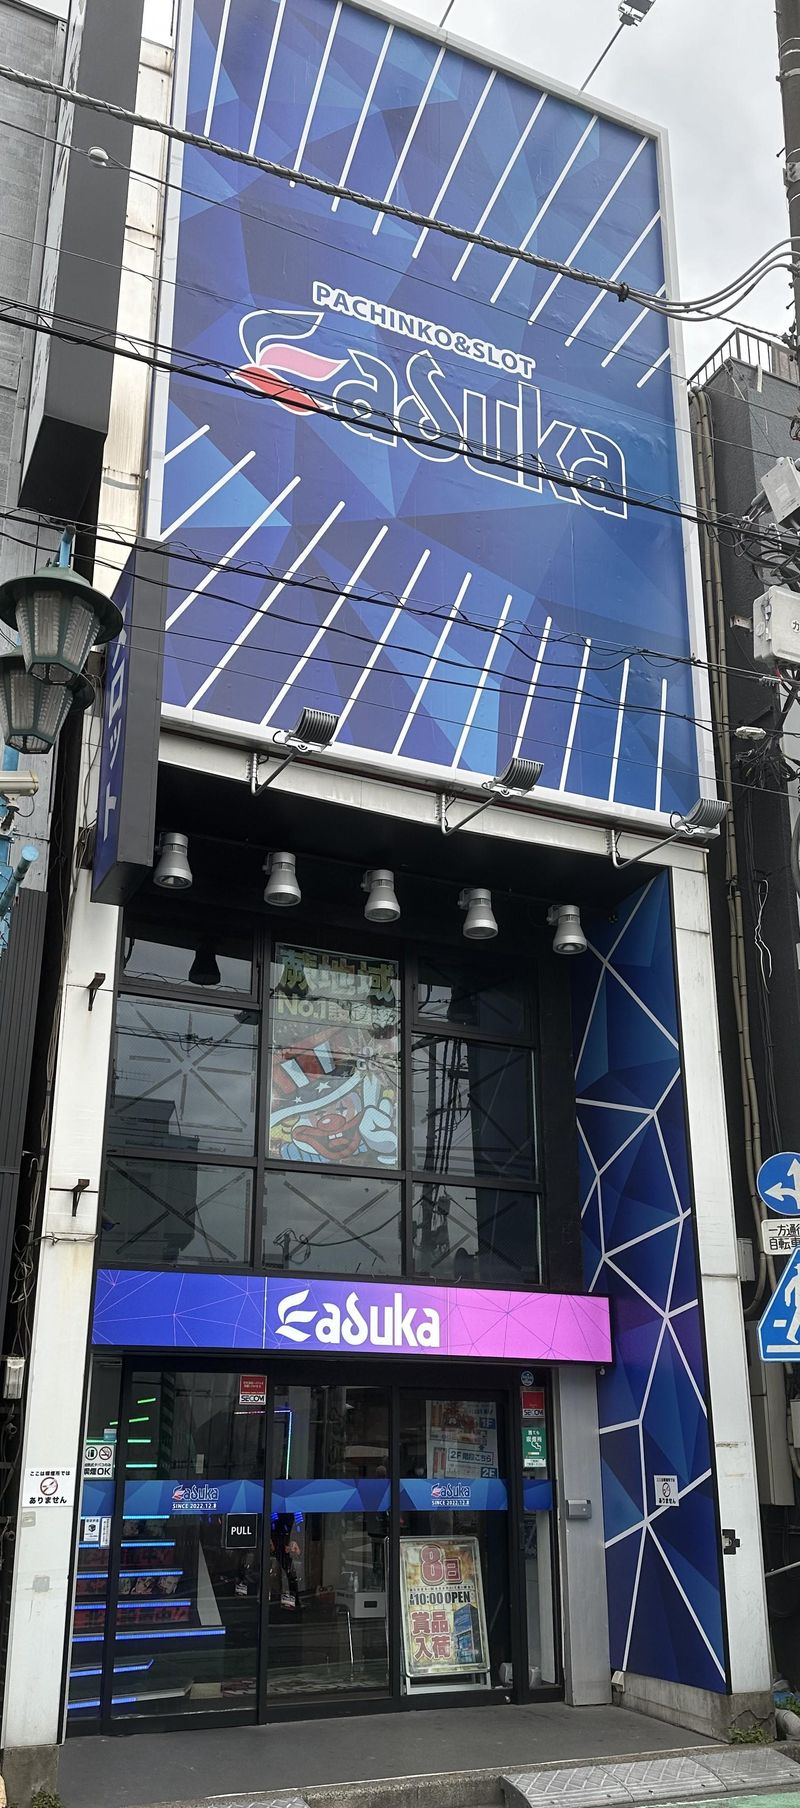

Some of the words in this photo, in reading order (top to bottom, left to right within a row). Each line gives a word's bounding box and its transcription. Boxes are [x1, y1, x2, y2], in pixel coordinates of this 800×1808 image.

[313, 281, 535, 379] PACHINKO&SLOT
[29, 1496, 67, 1505] ありません
[231, 1525, 252, 1535] PULL
[414, 1592, 443, 1605] 10:00
[445, 1591, 470, 1604] OPEN
[411, 1611, 450, 1635] 賞品
[414, 1635, 451, 1661] 入荷
